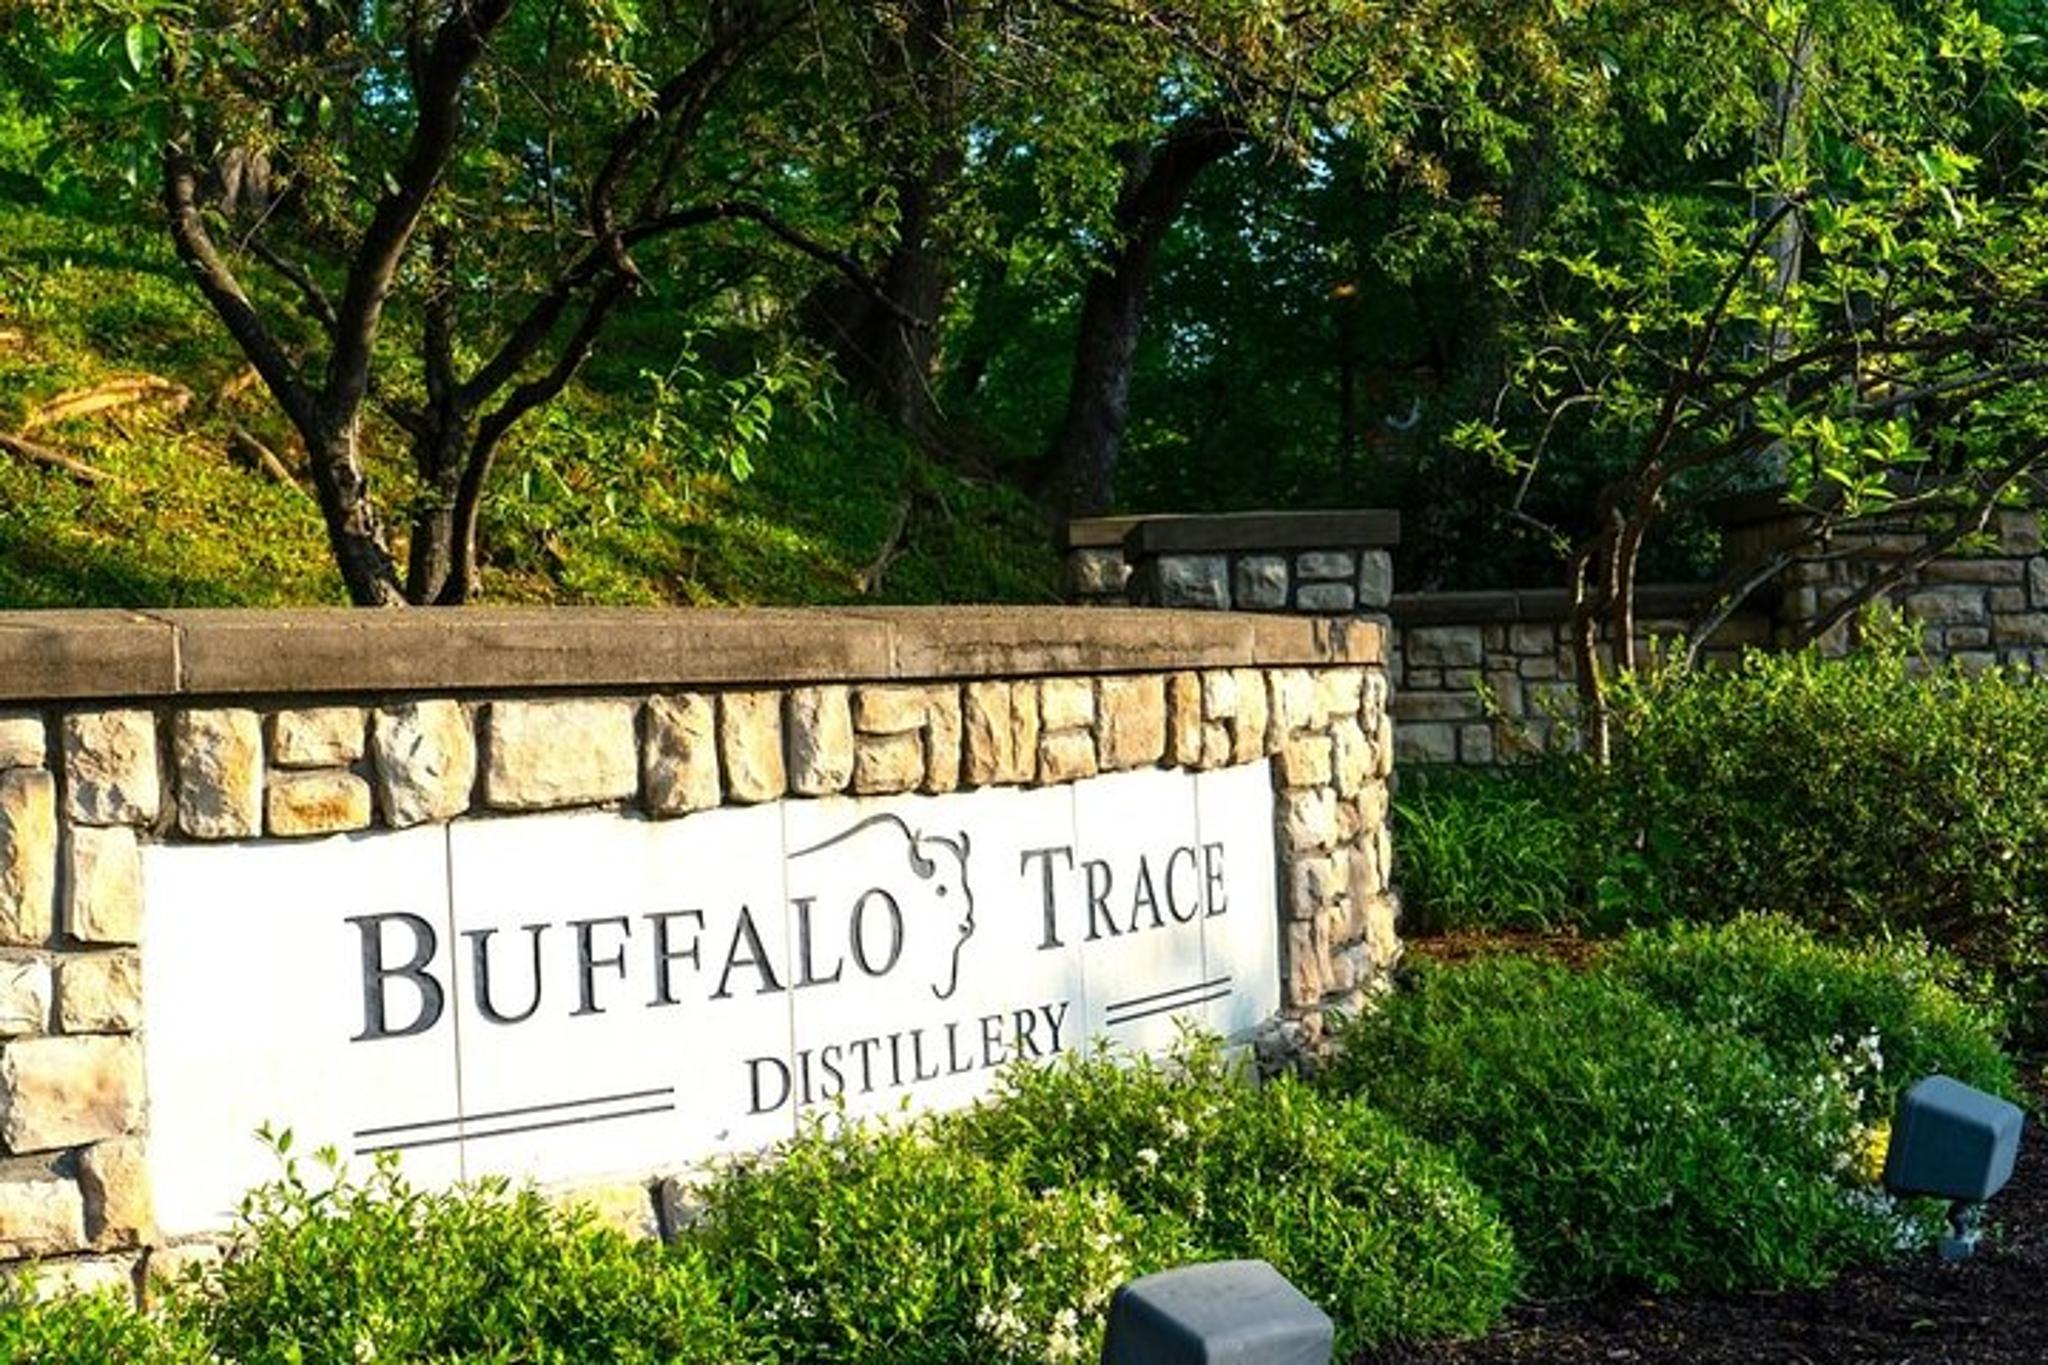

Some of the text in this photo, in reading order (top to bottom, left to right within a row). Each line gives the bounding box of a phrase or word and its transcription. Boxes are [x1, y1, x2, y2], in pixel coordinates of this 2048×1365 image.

[344, 842, 1229, 1043] BUFFALO TRACE
[744, 1000, 1070, 1115] DISTILLERY
